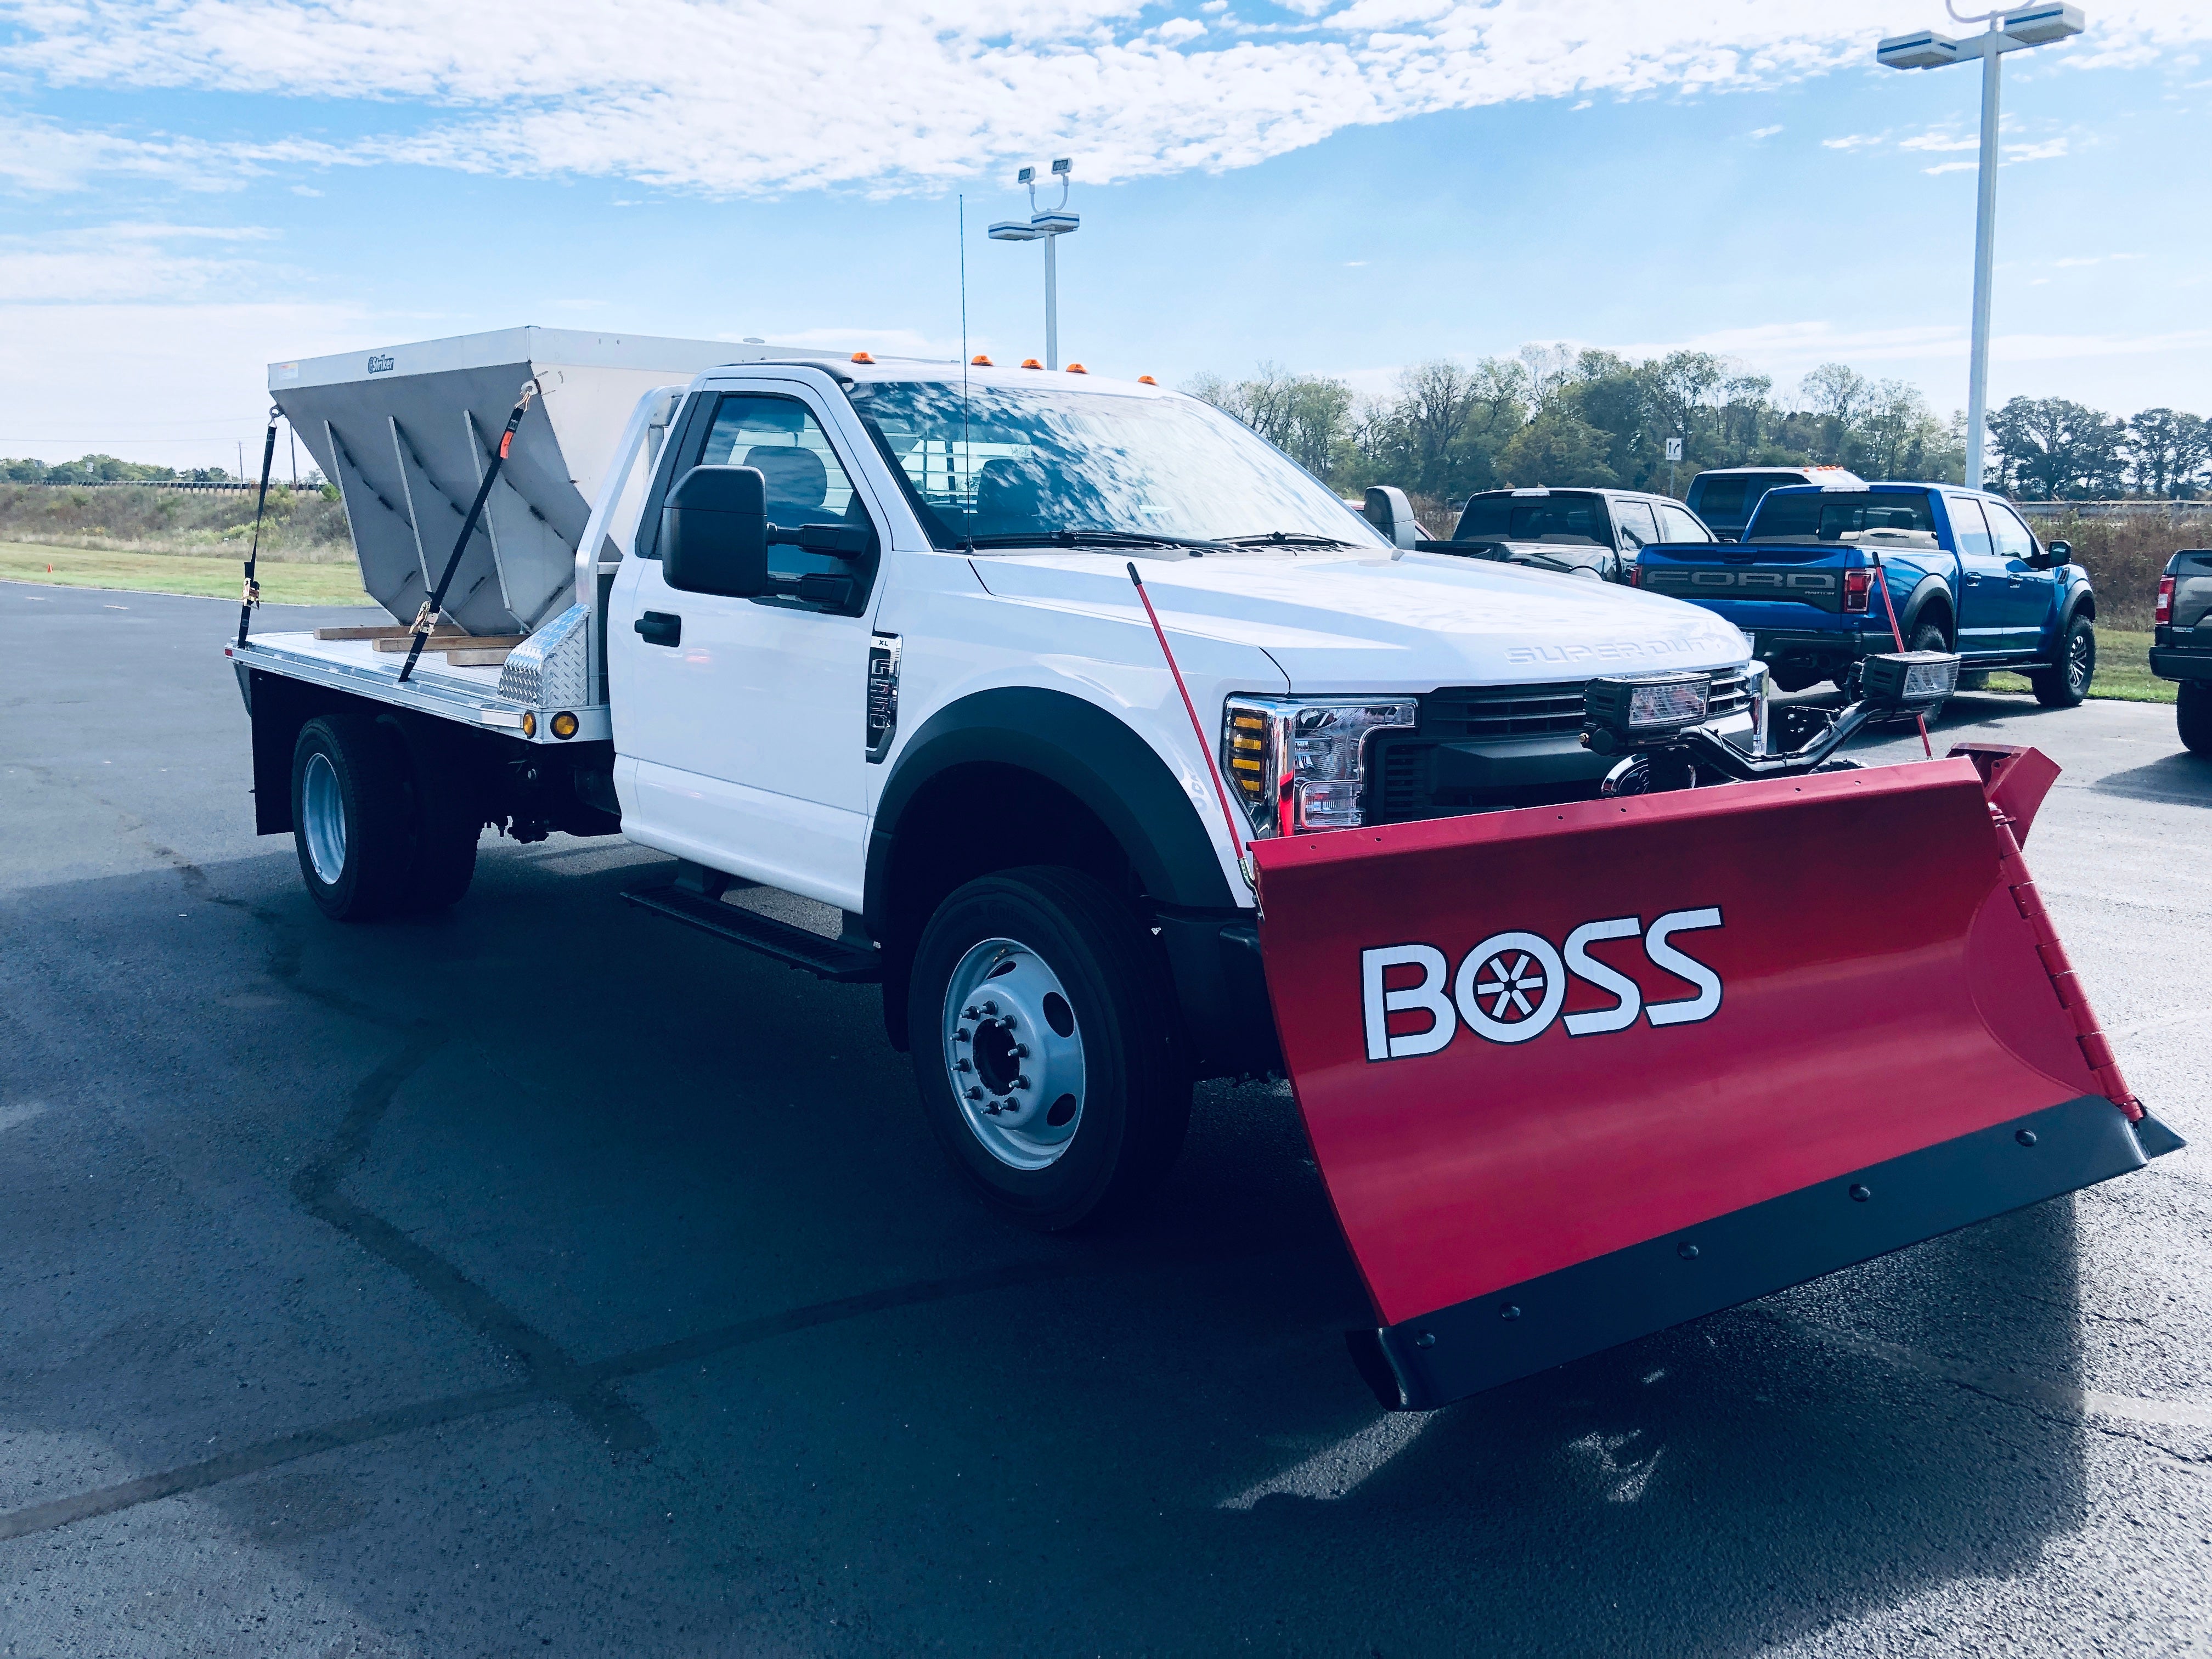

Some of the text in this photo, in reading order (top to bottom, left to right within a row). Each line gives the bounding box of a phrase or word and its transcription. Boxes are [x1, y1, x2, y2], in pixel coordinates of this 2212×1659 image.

[1646, 571, 1835, 588] FORD
[1505, 636, 1724, 665] SUPER DUTY
[1361, 905, 1724, 1063] BOSS
